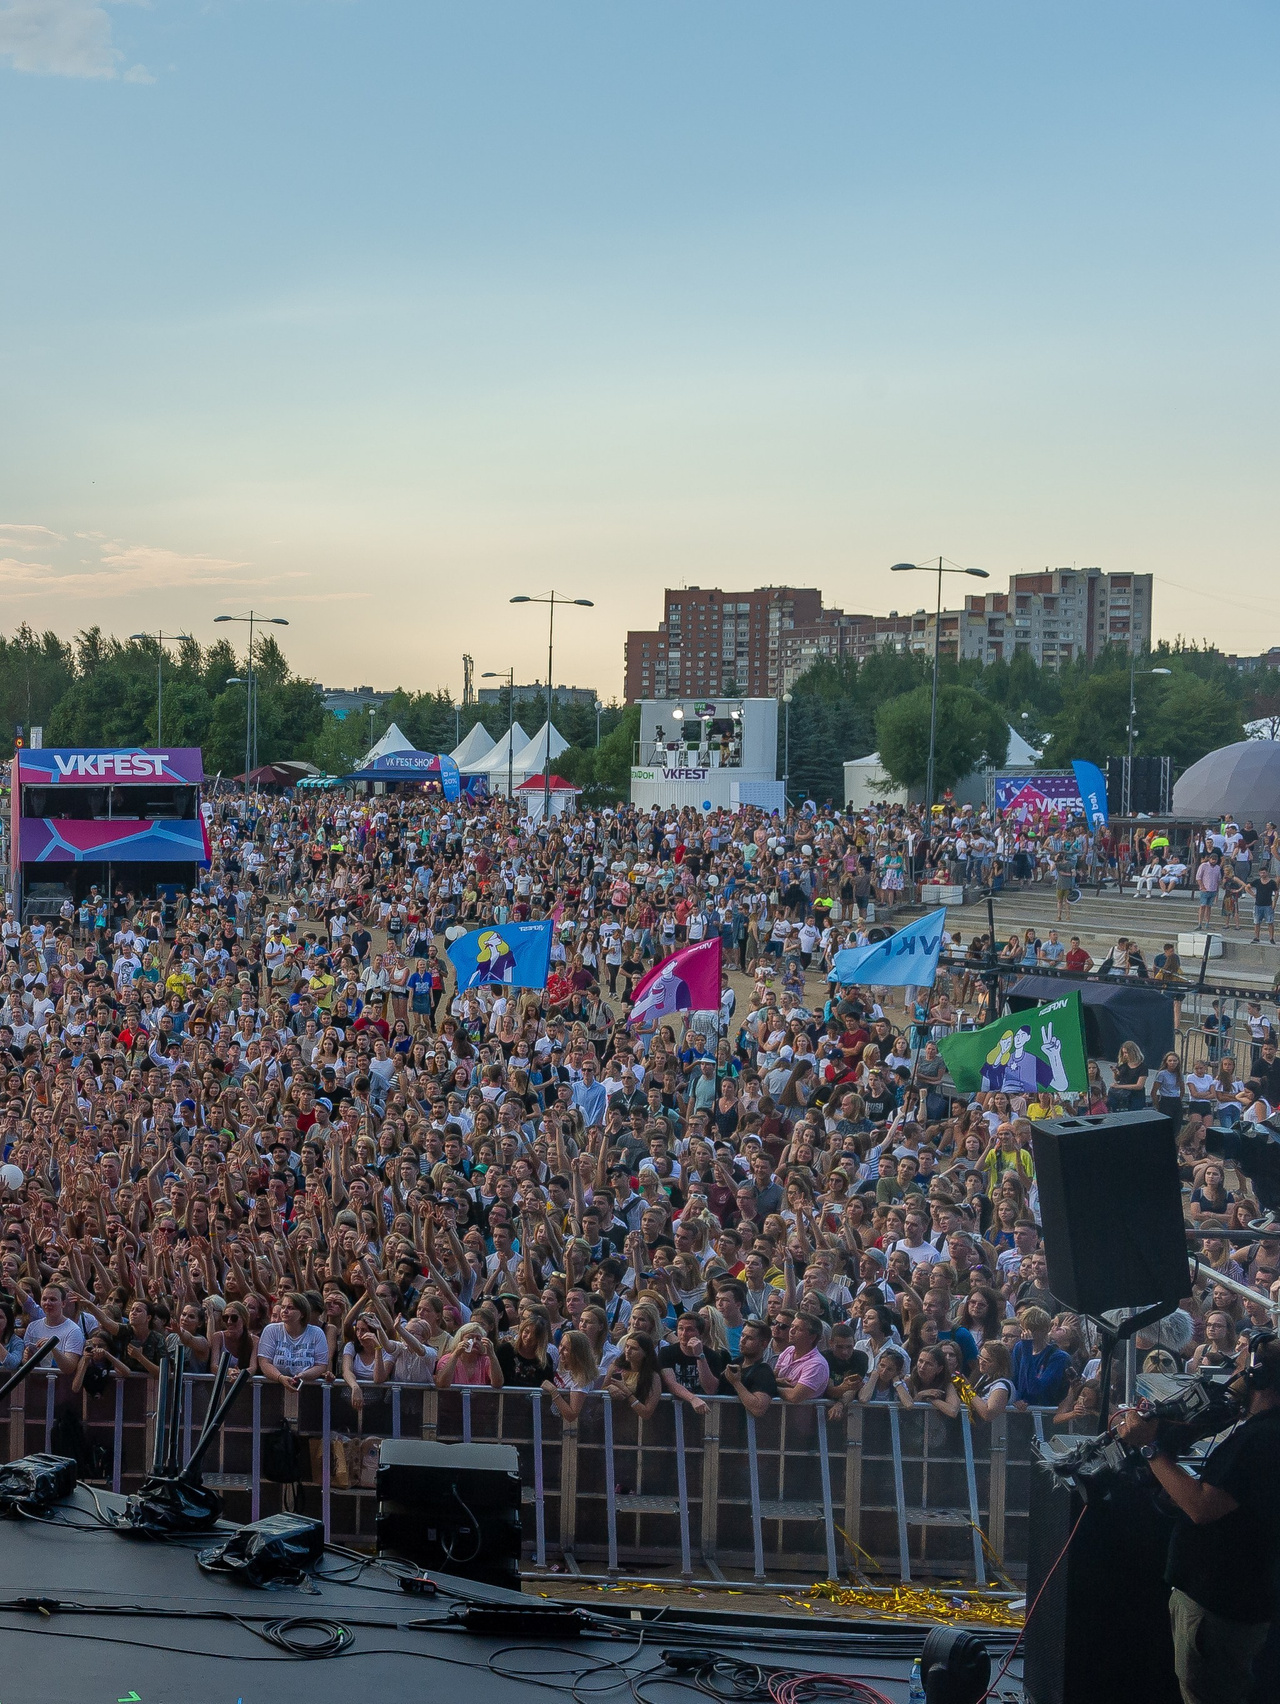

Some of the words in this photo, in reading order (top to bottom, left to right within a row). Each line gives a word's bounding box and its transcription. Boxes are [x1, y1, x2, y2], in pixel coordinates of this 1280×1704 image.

[53, 754, 169, 776] VKFEST
[385, 757, 395, 767] VK
[395, 757, 413, 767] FEST
[414, 758, 434, 768] SHOP
[662, 768, 709, 780] VKFEST
